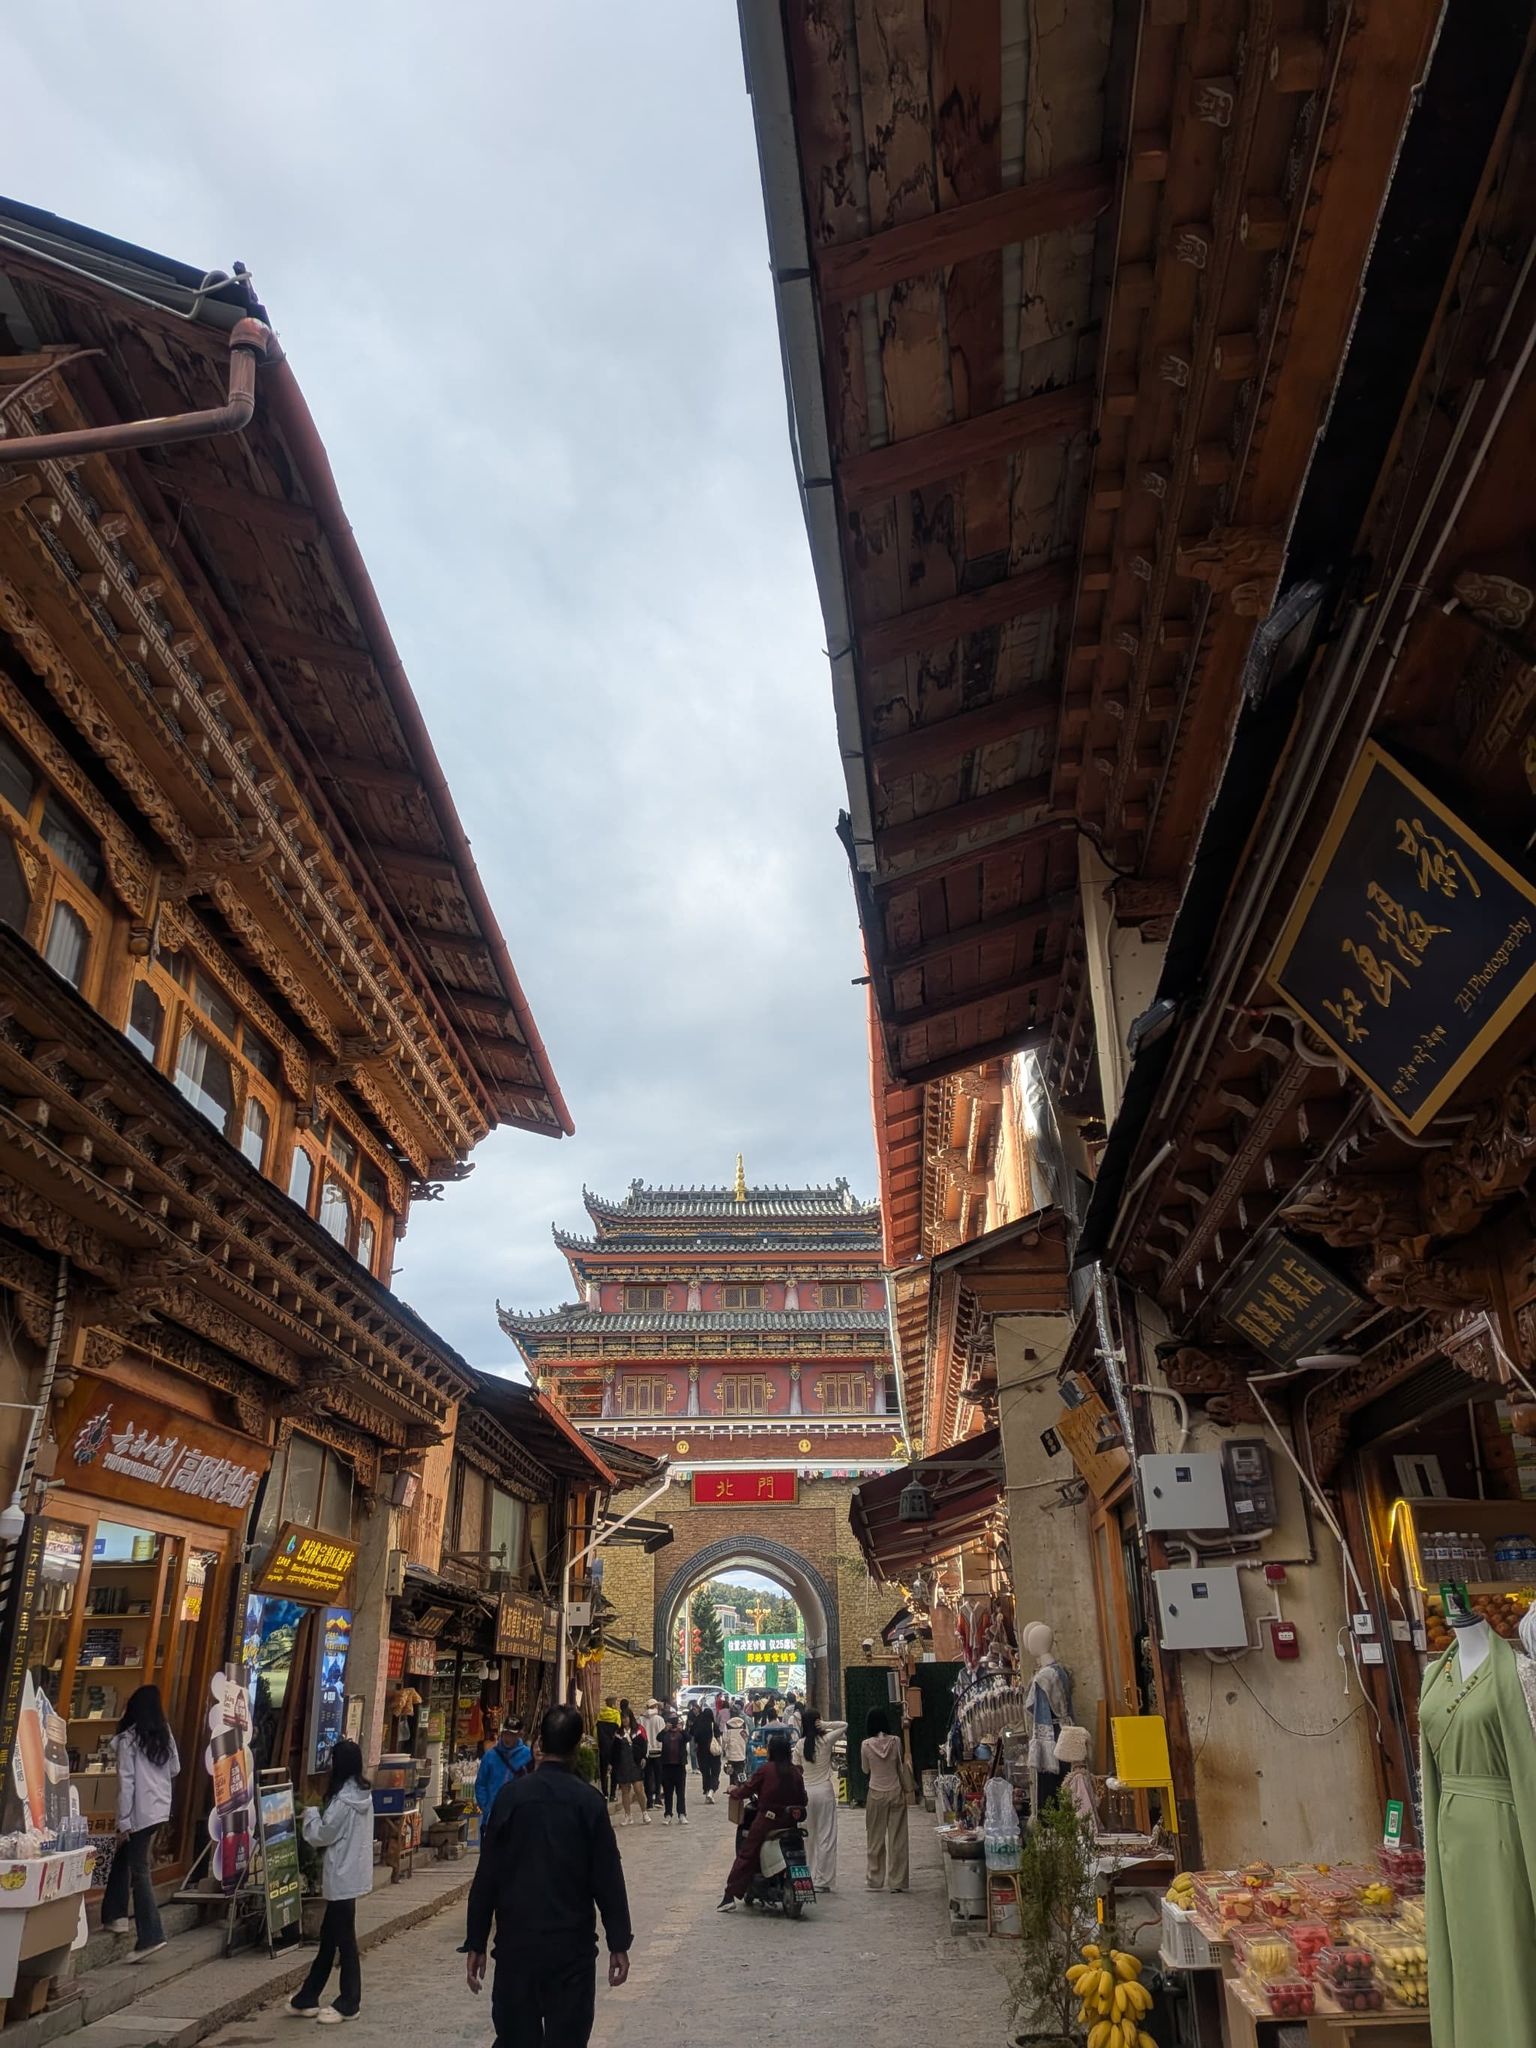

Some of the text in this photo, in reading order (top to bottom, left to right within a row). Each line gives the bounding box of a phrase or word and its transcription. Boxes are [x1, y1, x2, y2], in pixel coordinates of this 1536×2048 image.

[1453, 915, 1534, 1014] ZH Photography
[169, 1448, 261, 1509] 高原体验店
[716, 1475, 775, 1499] 北門
